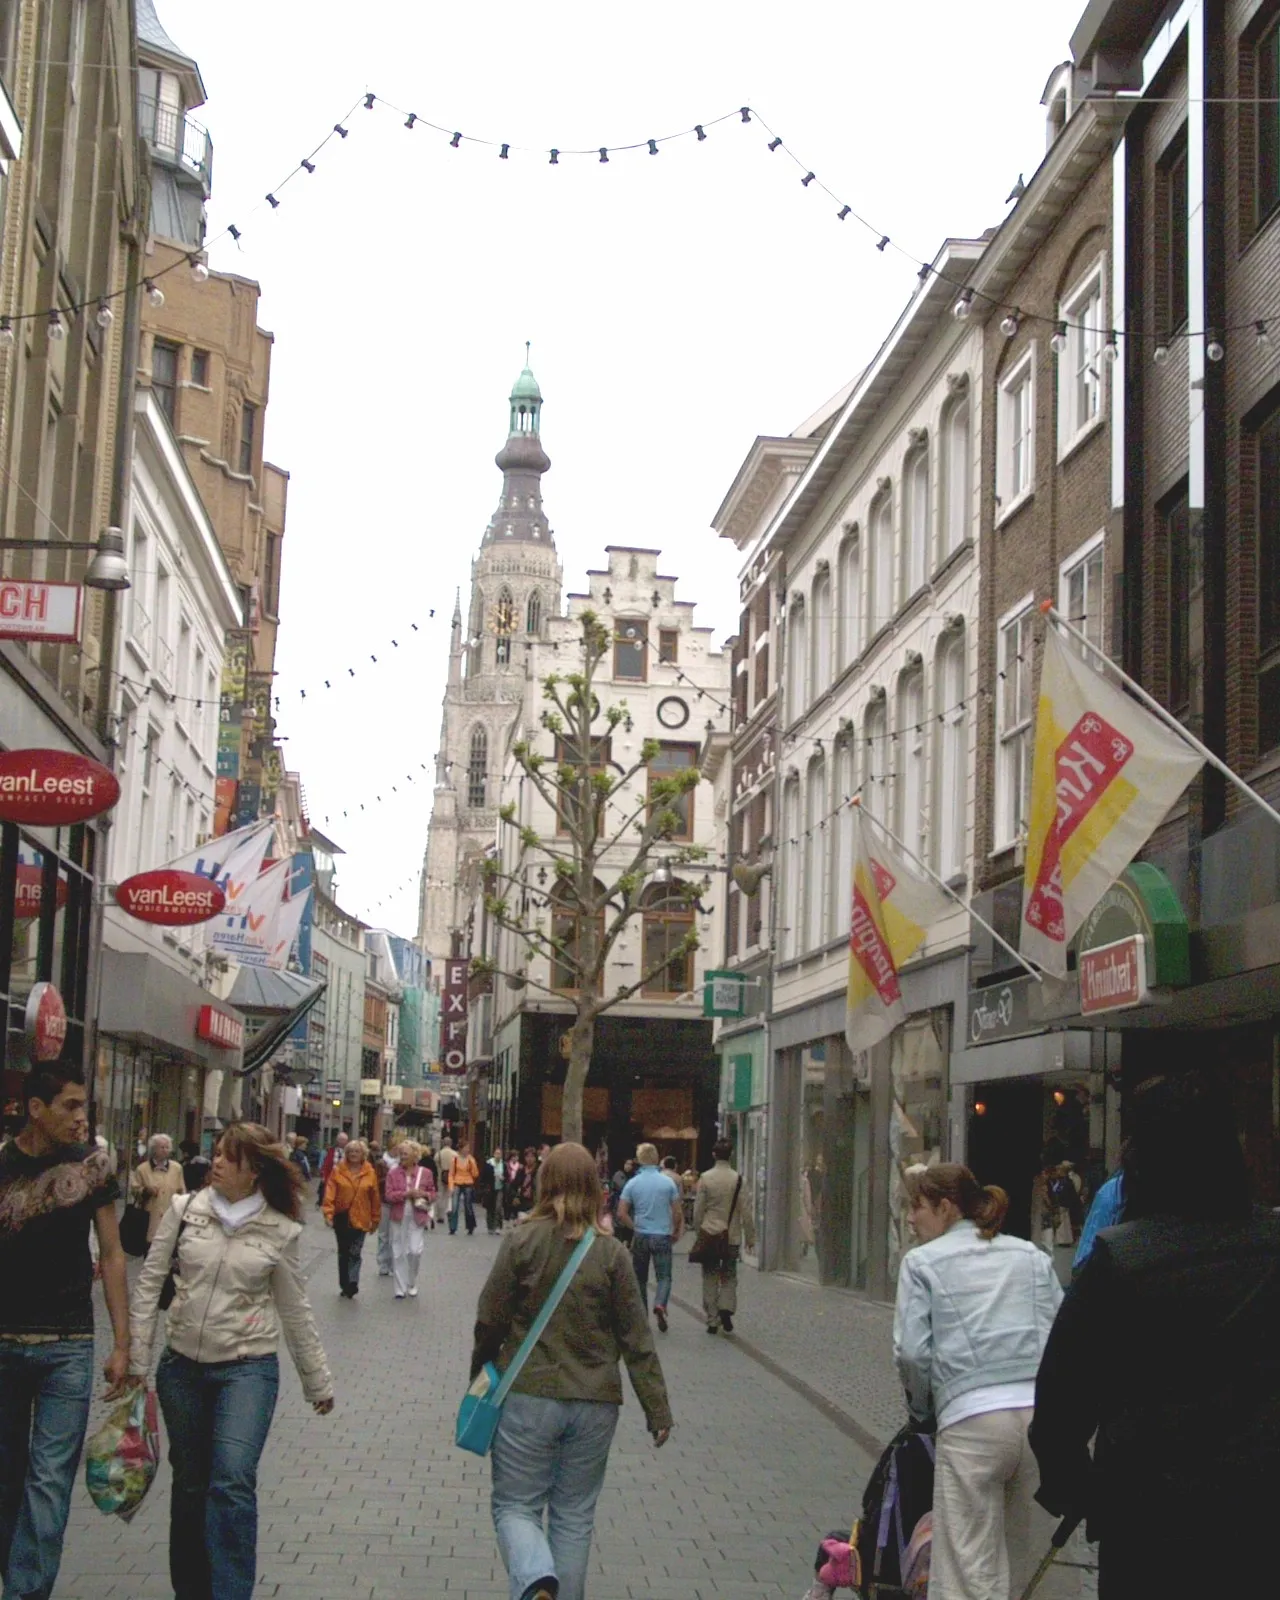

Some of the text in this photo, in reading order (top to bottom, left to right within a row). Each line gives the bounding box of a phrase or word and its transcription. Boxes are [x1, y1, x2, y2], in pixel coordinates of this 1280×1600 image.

[0, 585, 48, 620] CH
[128, 885, 213, 907] vanLeest
[1087, 950, 1131, 1000] Kruidvat
